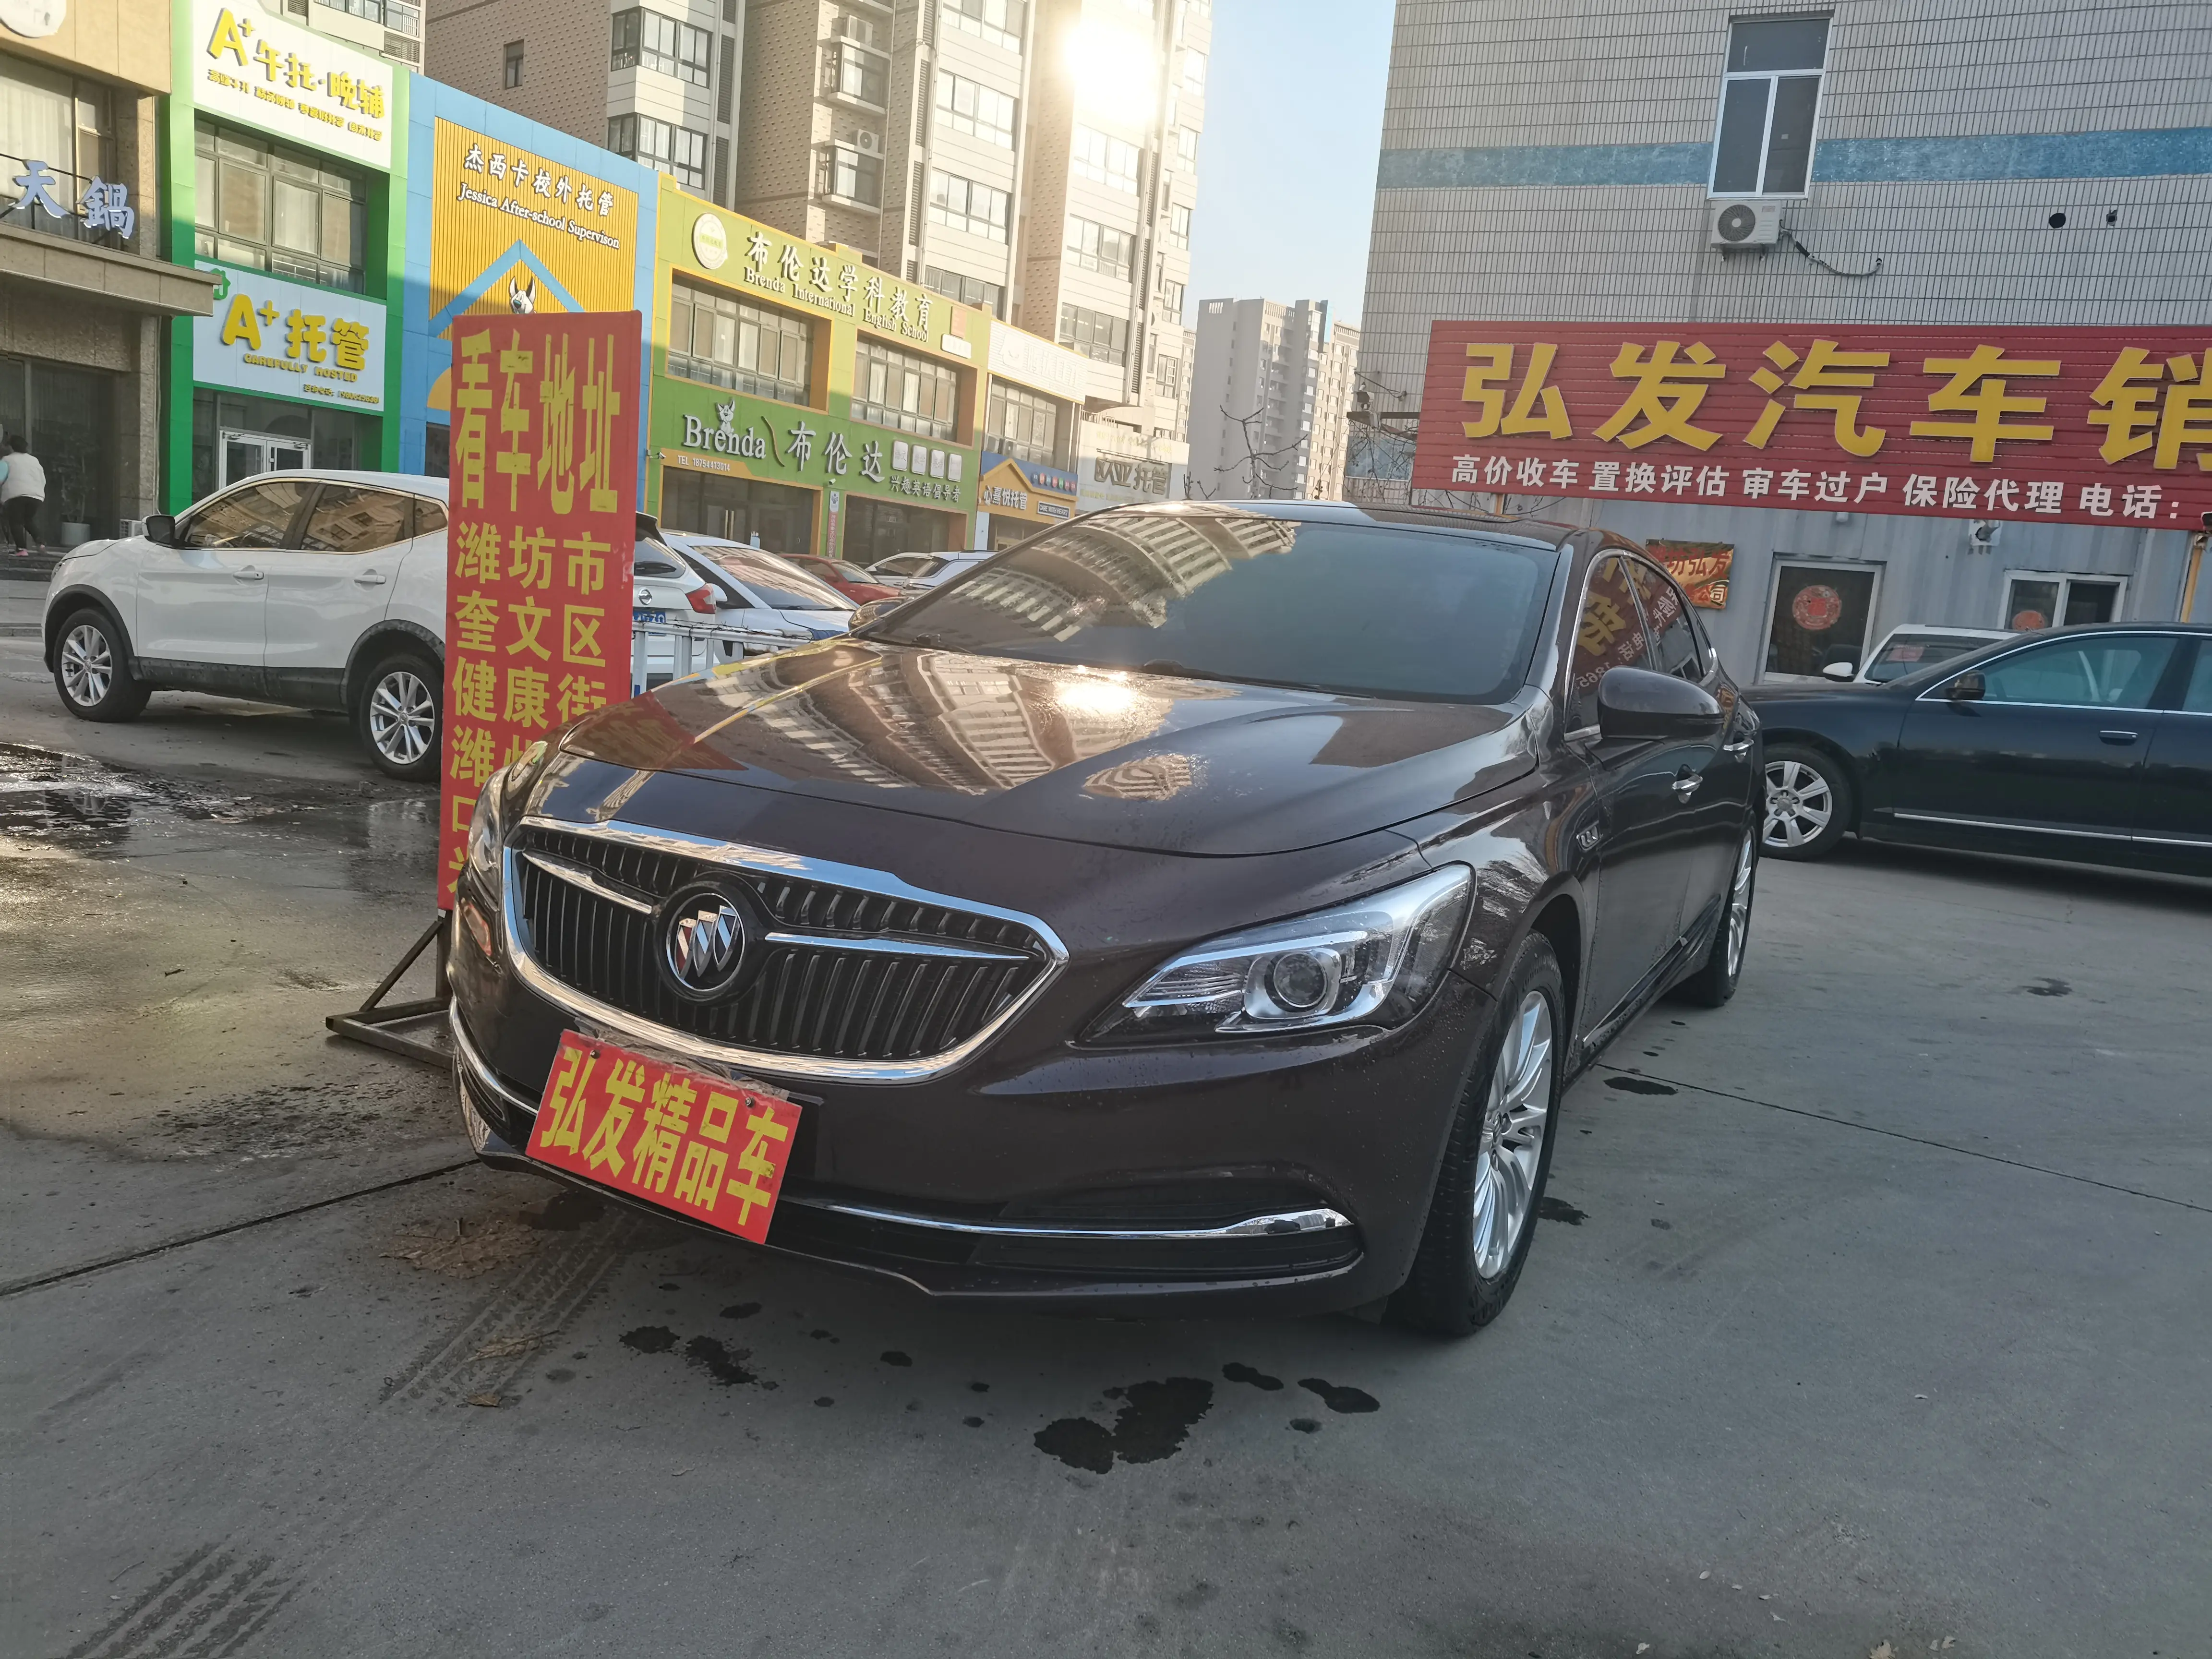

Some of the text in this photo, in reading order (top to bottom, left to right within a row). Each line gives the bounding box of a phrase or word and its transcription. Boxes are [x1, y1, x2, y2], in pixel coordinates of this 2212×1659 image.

[458, 183, 497, 208] Jessica
[567, 220, 620, 249] Supervison
[464, 144, 614, 216] 杰西卡校外托管
[744, 267, 785, 293] Brenda
[793, 284, 855, 317] International
[863, 308, 896, 332] English
[901, 321, 929, 342] School
[745, 231, 933, 330] 布伦达学科教育
[243, 353, 358, 382] CAREFULLY HOSTED
[456, 328, 620, 514] 看车地址
[683, 414, 885, 483] Brenda 布伦达
[677, 455, 730, 471] TEL 18754413014
[890, 476, 961, 502] 兴趣英语倡导者
[1452, 454, 1579, 489] 高价收车
[1589, 461, 1730, 496] 置换评估
[1743, 468, 1887, 504] 审车过户
[1903, 474, 2064, 513] 保险代理
[1057, 508, 1068, 516] HEART
[455, 521, 611, 595] 潍坊市
[455, 590, 606, 667] 奎文区
[451, 656, 606, 729] 健康街
[540, 1047, 788, 1226] 弘发精品车
